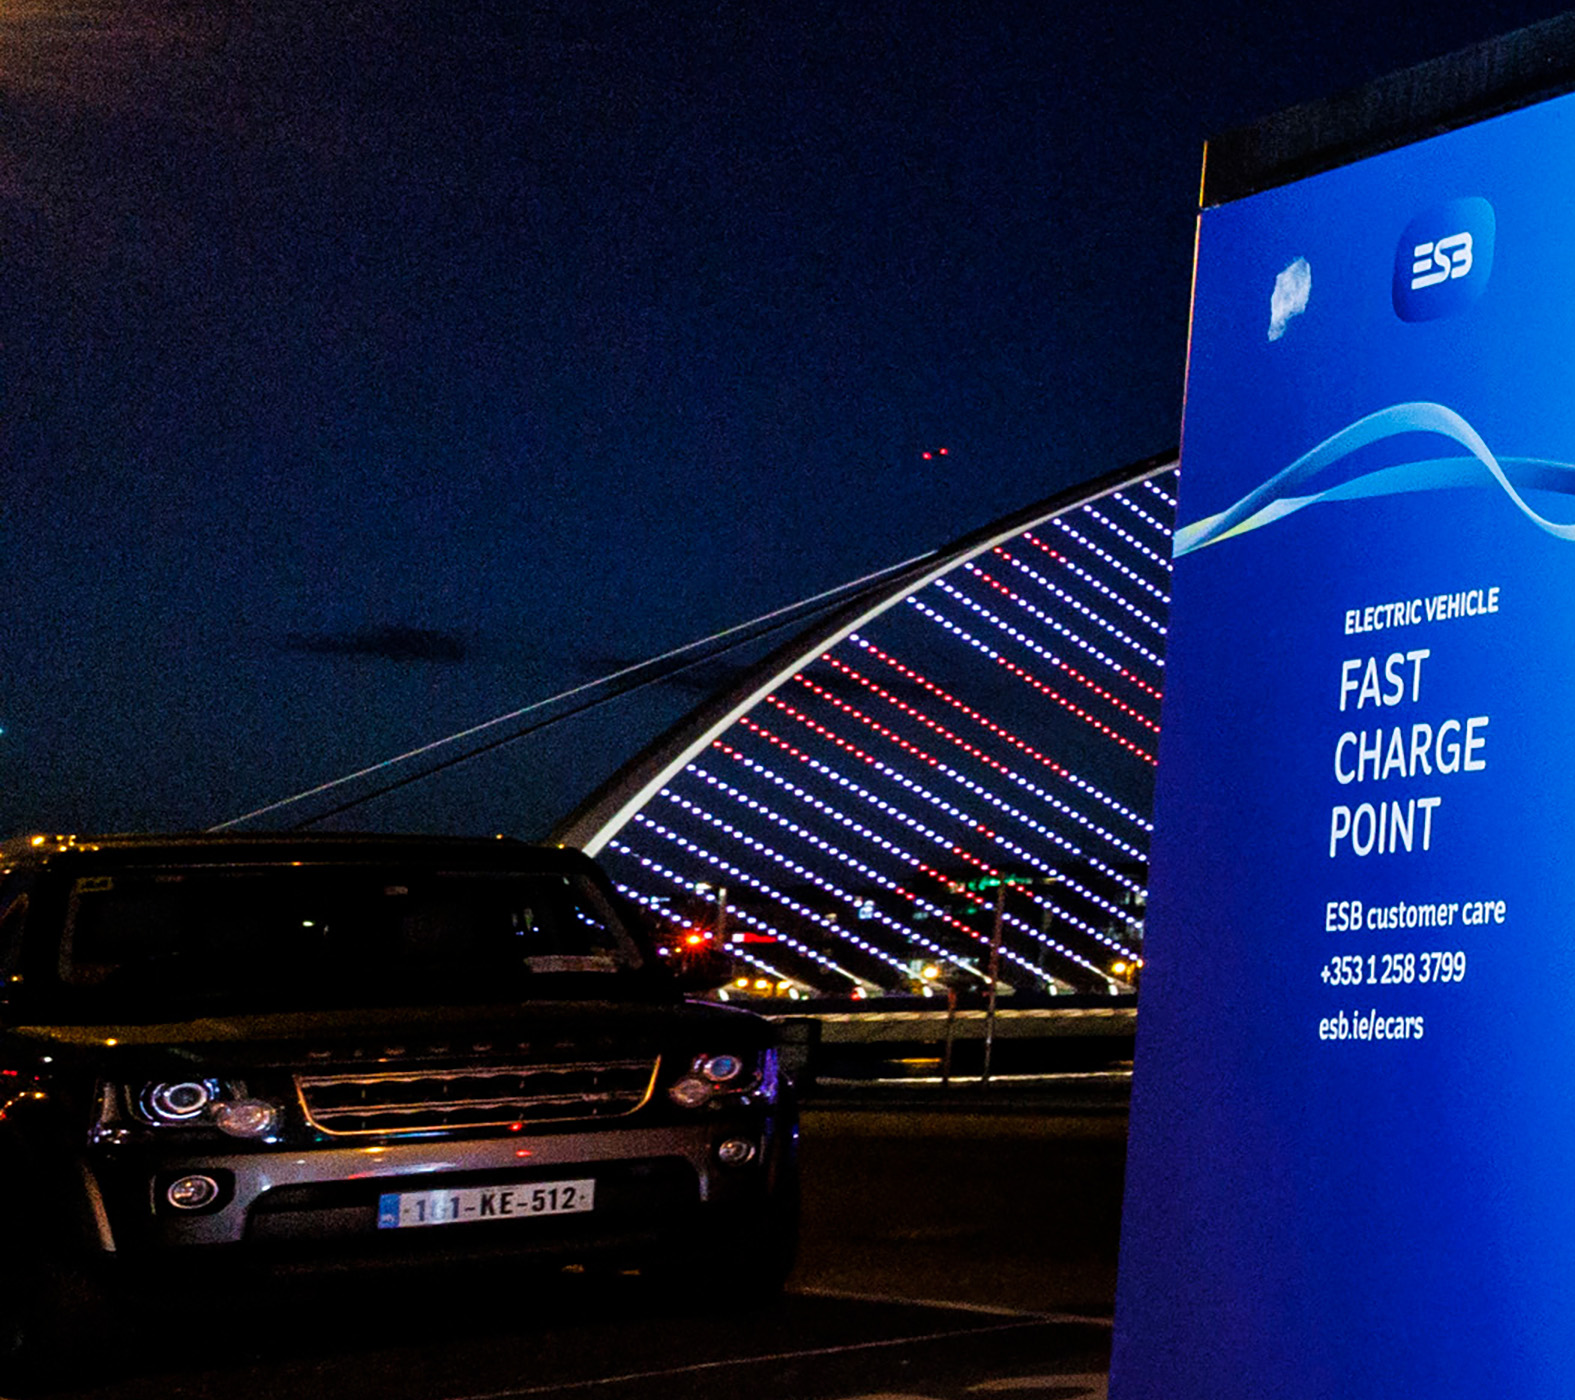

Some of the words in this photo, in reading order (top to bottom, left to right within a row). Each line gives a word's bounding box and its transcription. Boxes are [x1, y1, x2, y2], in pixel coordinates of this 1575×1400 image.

[1411, 231, 1473, 290] ESB
[1344, 599, 1423, 635] ELECTRIC
[1425, 587, 1500, 622] VEHICLE
[1339, 649, 1431, 712] FAST
[1334, 716, 1490, 784] CHARGE
[1329, 796, 1441, 858] POINT
[1325, 900, 1363, 932] ESB
[1367, 901, 1459, 930] customer
[1462, 900, 1506, 926] care
[1320, 955, 1363, 986] +353
[1366, 955, 1378, 985] 1
[1380, 953, 1416, 985] 258
[1419, 950, 1467, 984] 3799
[1319, 1009, 1425, 1041] esb.ie/ecars
